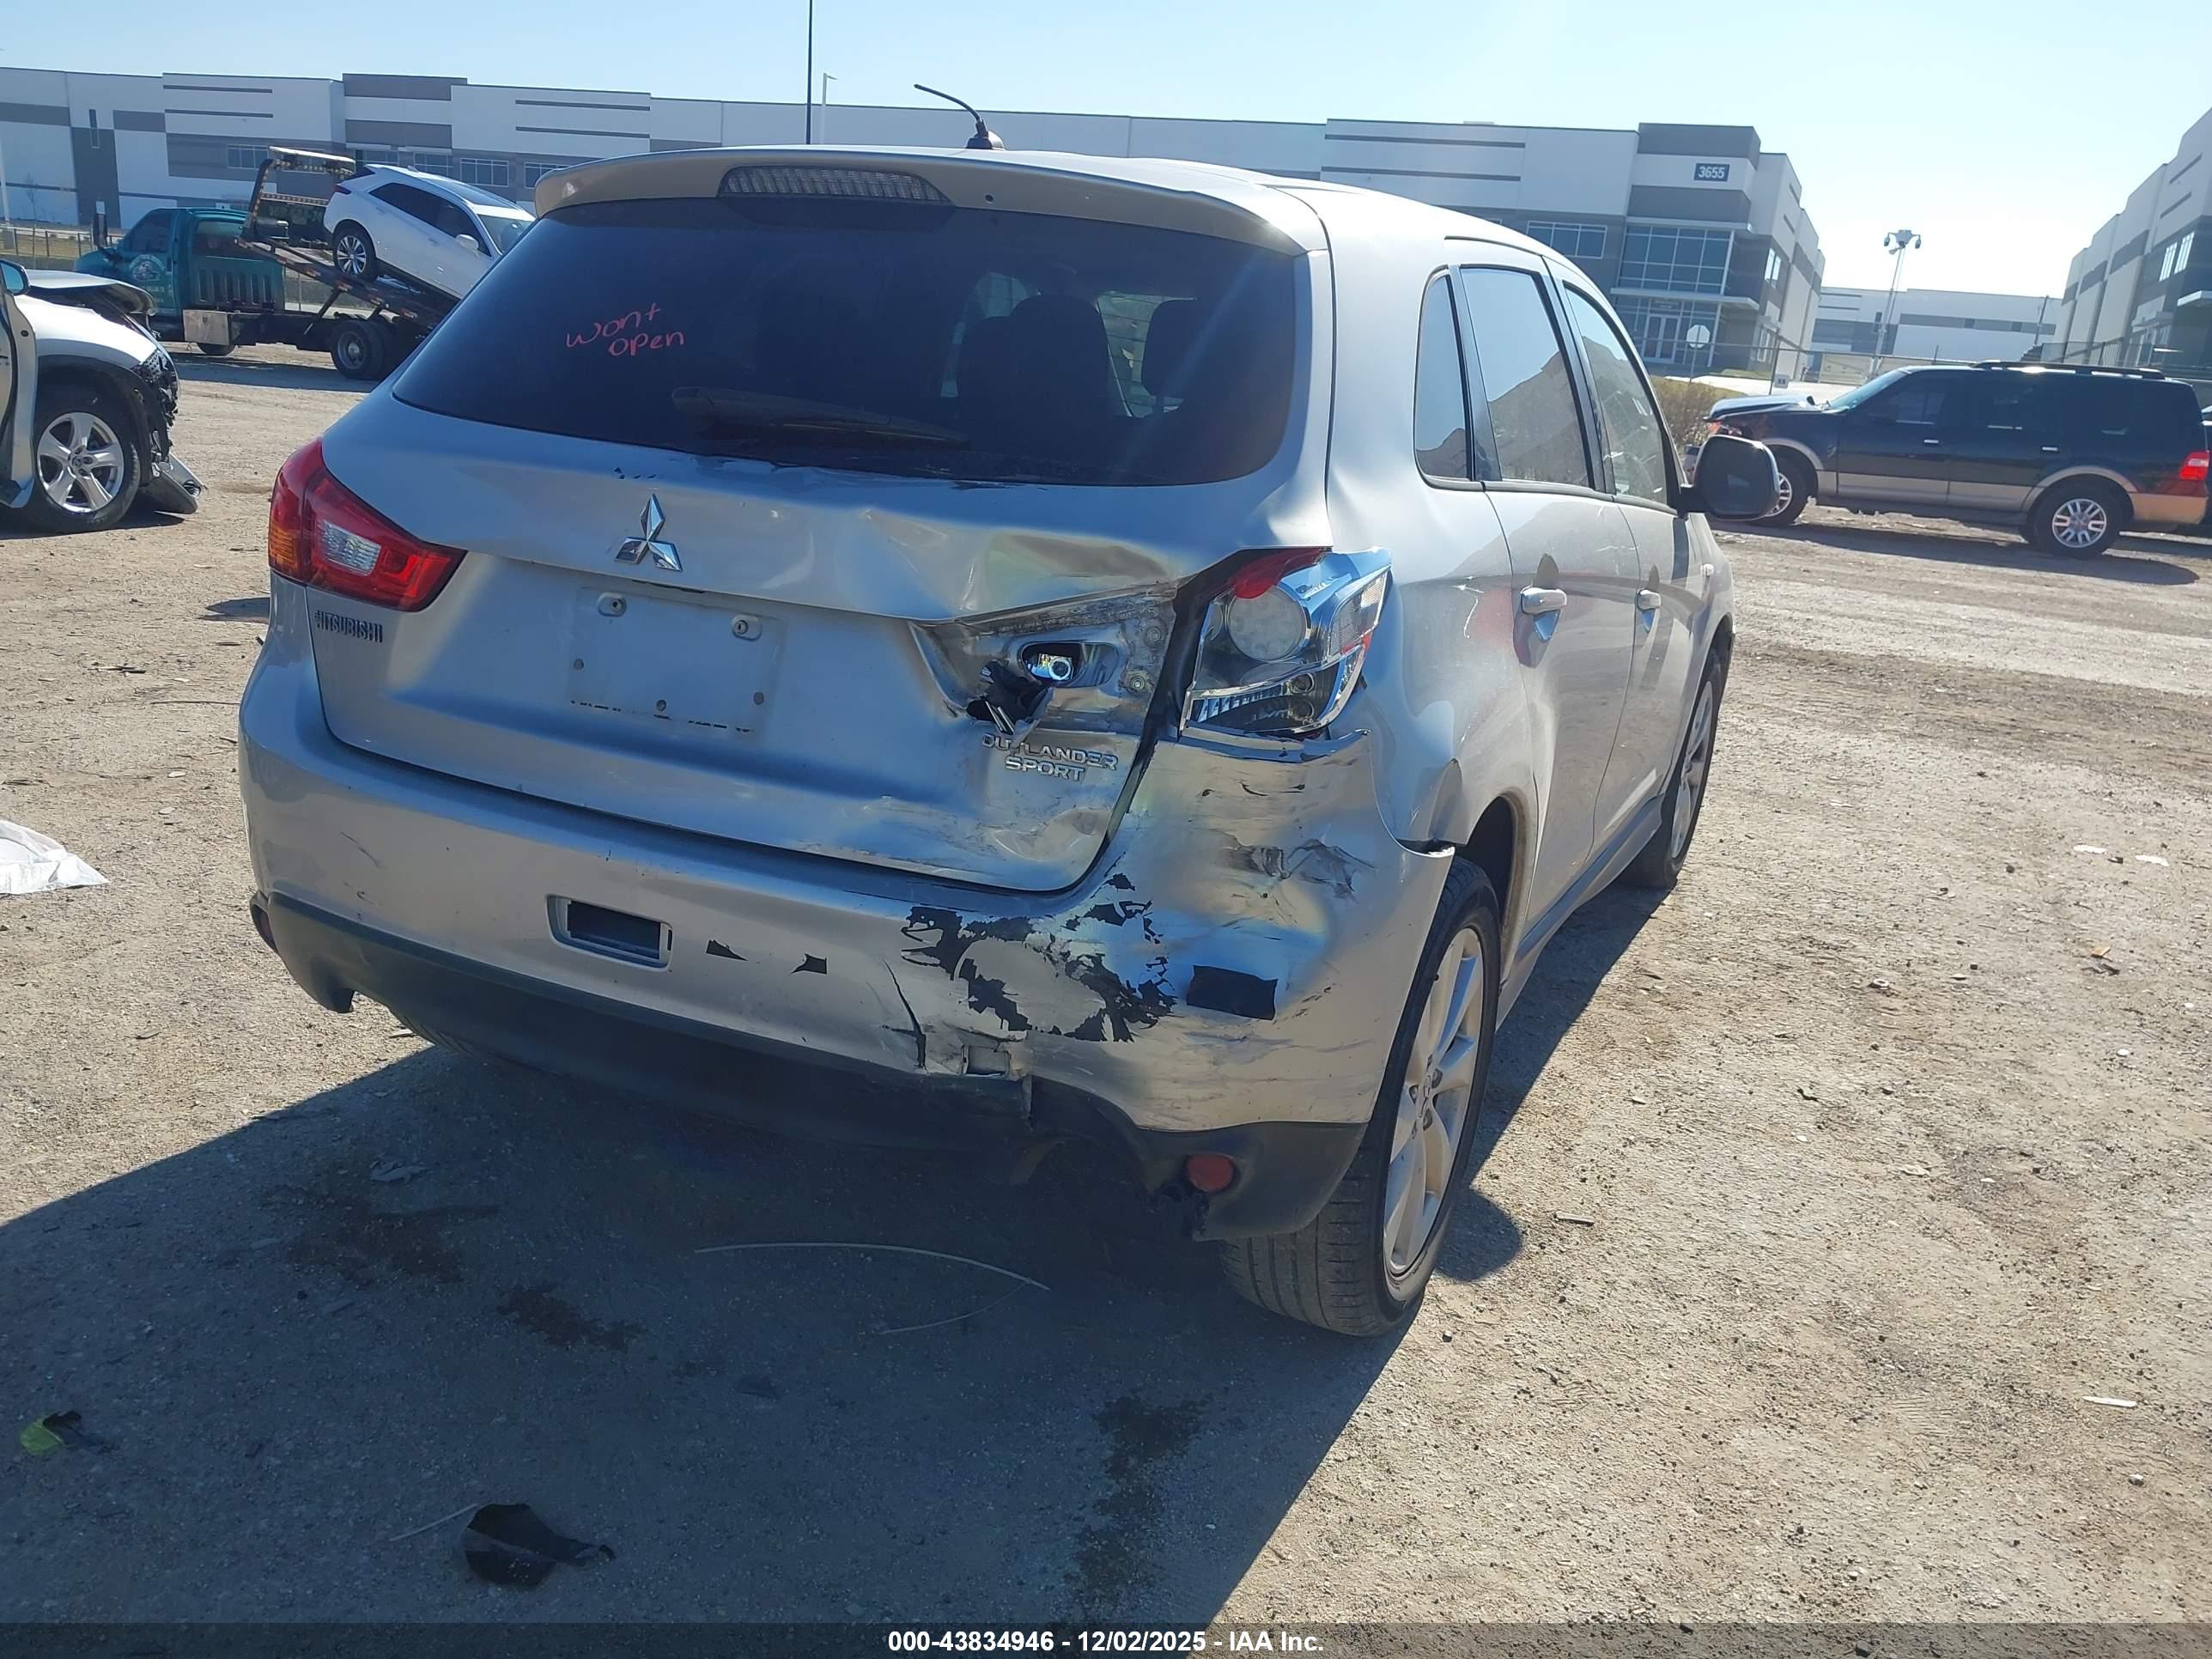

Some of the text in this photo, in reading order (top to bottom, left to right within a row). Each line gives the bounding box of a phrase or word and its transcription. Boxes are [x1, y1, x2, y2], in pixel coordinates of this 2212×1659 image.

[1698, 166, 1725, 179] 3655
[608, 331, 685, 356] open
[314, 610, 383, 643] MITSUBISHI
[1005, 755, 1086, 782] SPORT
